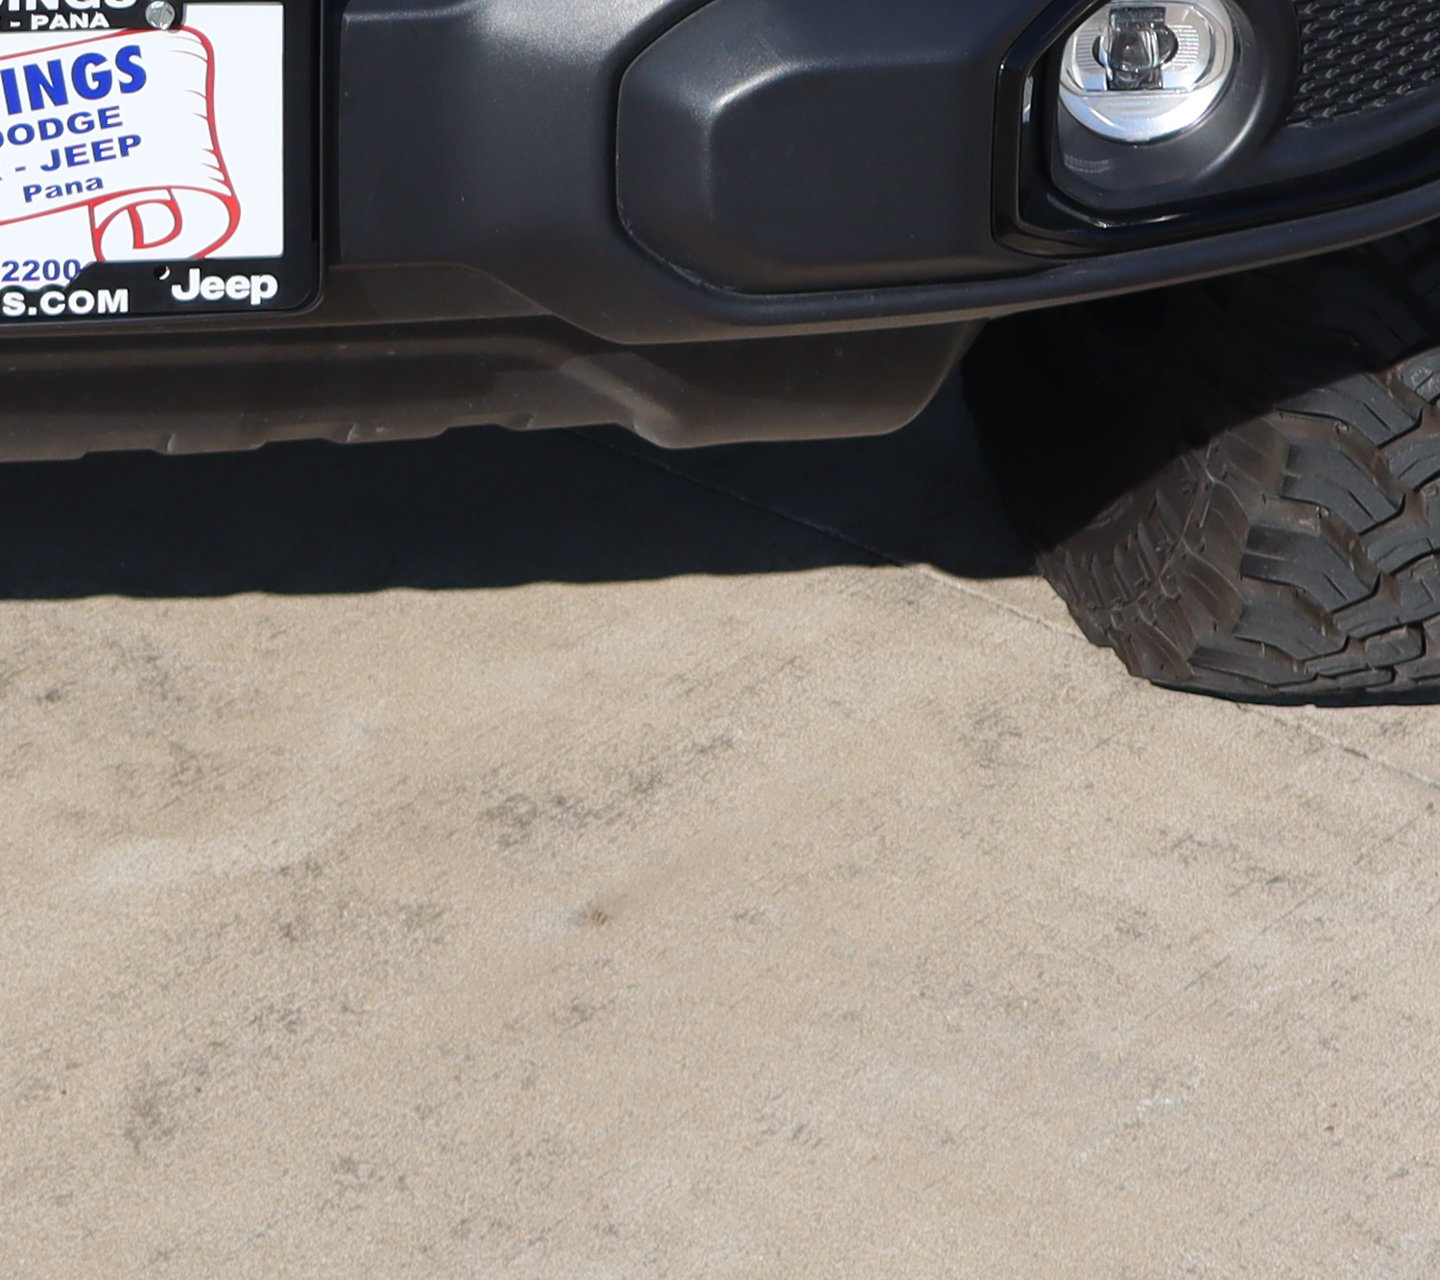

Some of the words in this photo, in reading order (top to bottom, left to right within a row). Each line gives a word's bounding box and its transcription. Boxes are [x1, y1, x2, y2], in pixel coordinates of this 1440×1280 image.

[30, 12, 110, 30] PANA
[40, 134, 142, 173] JEEP
[22, 174, 104, 203] Pana
[171, 268, 277, 305] Jeep
